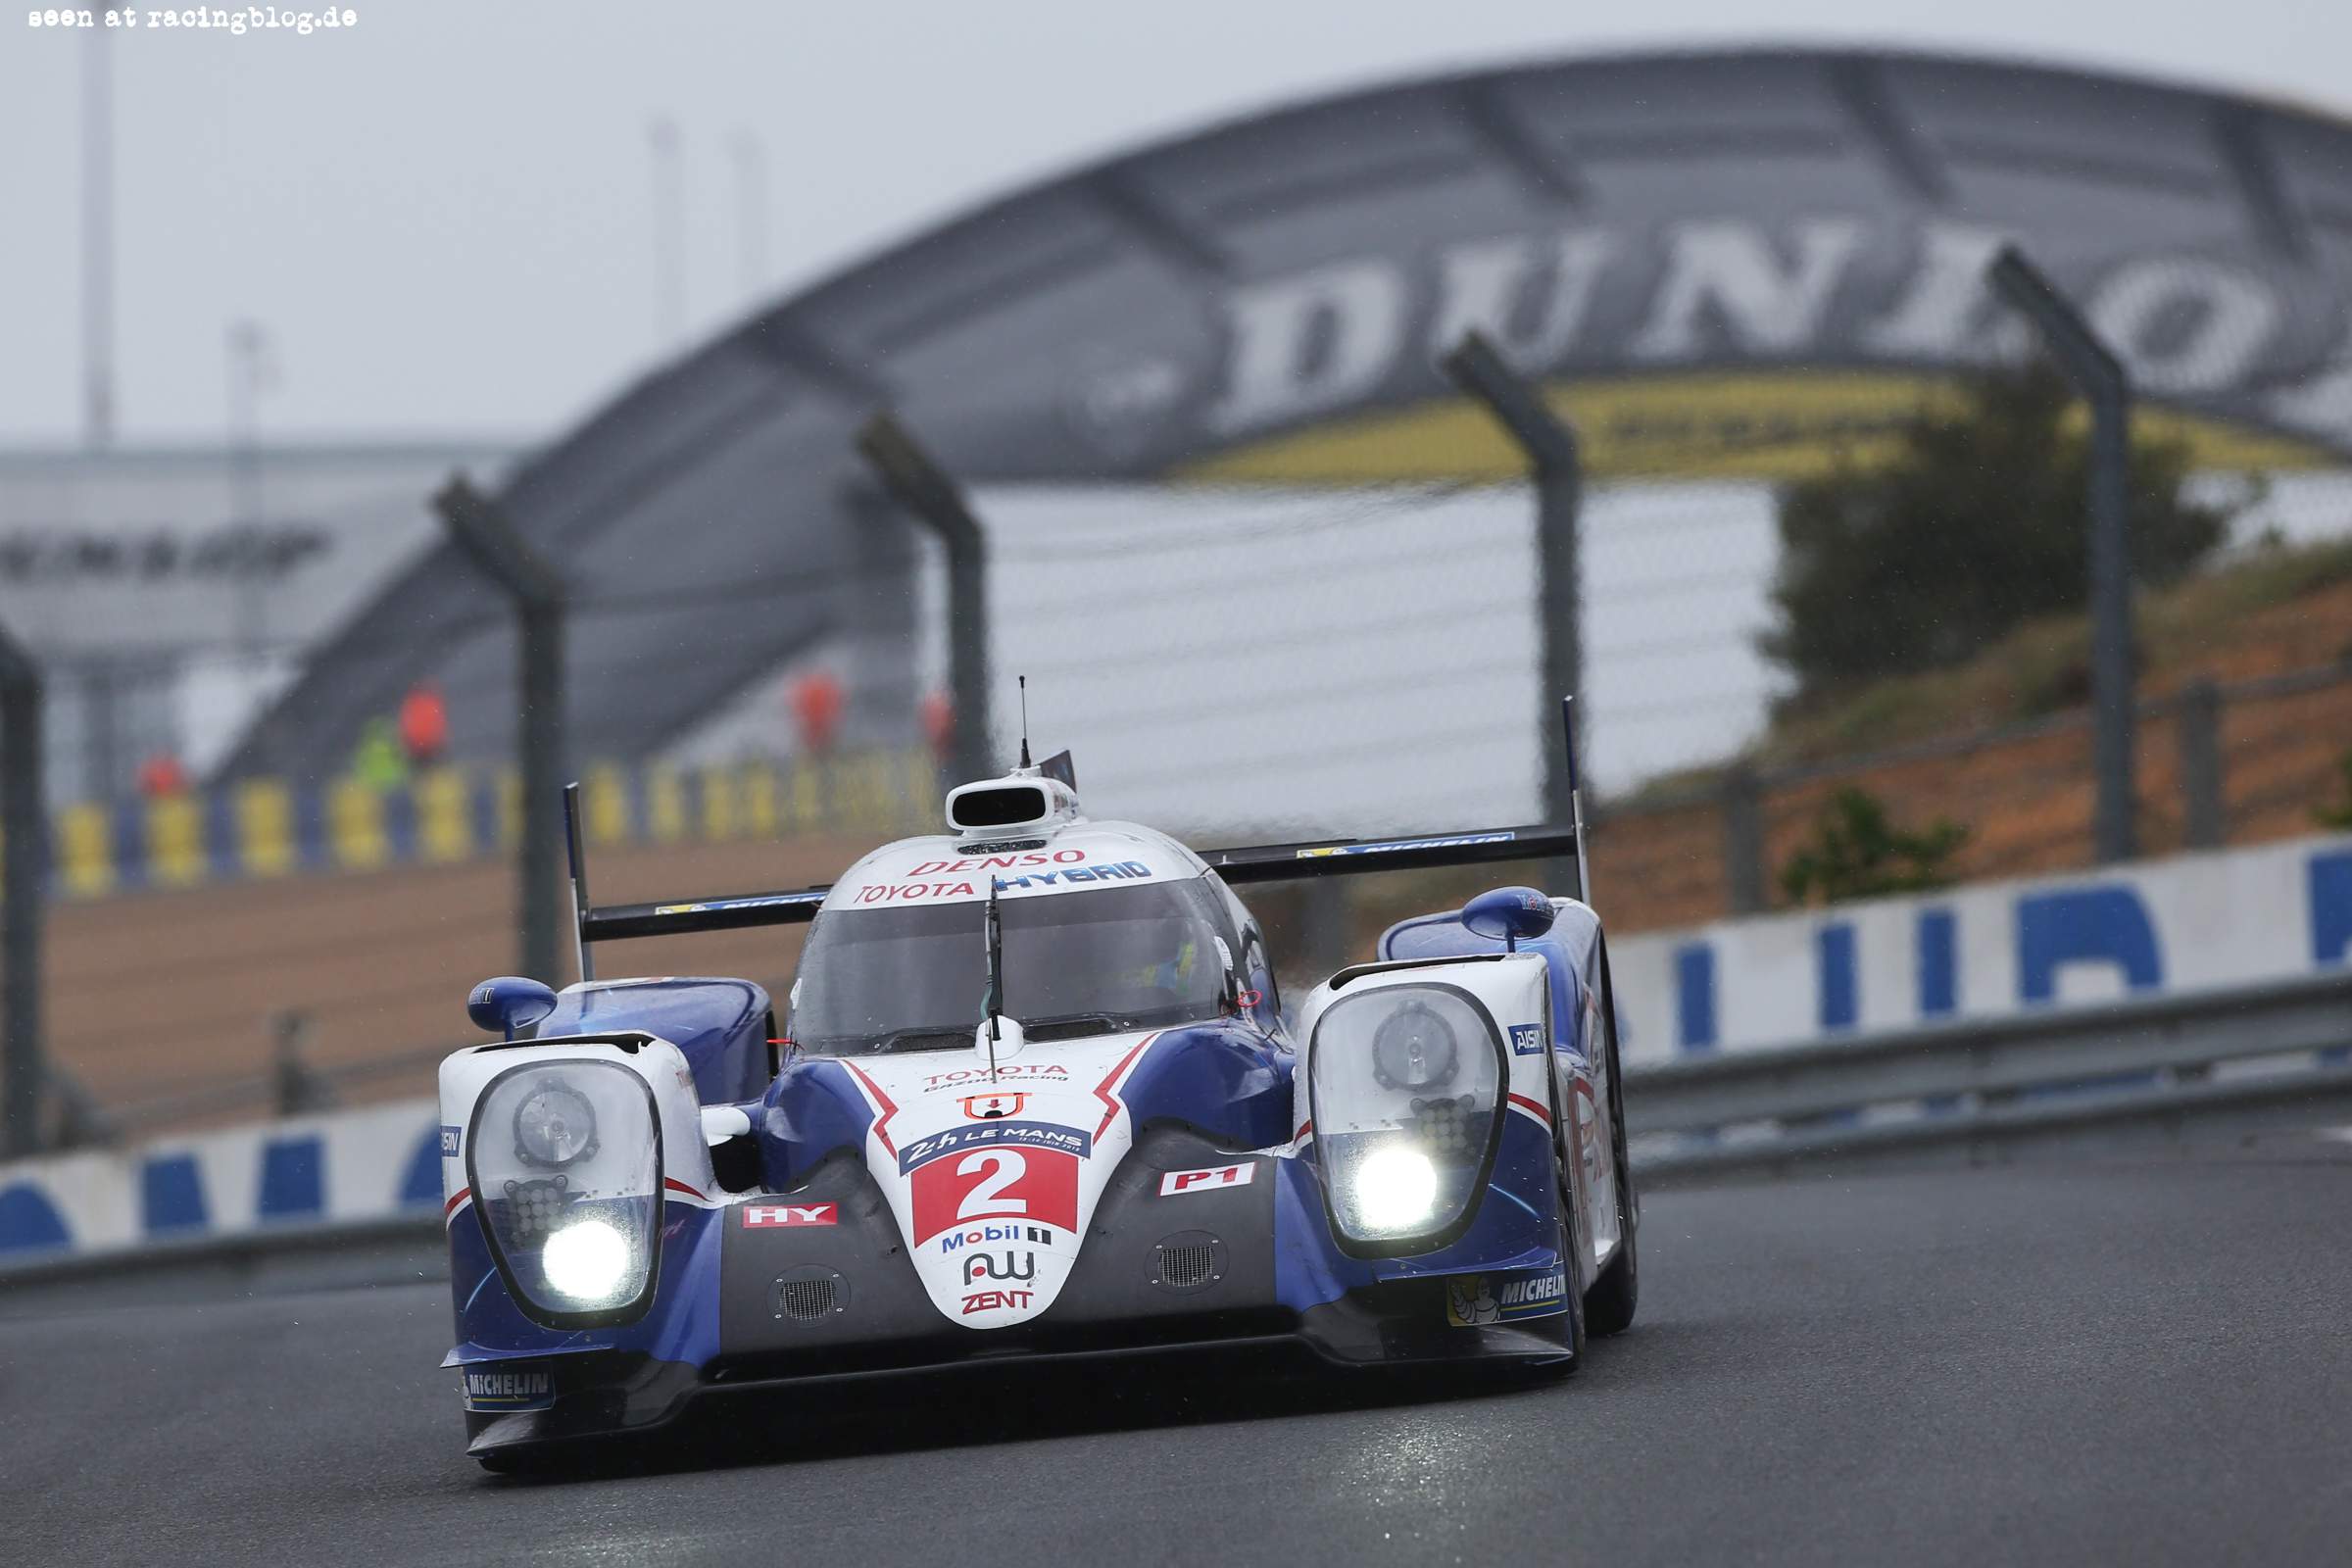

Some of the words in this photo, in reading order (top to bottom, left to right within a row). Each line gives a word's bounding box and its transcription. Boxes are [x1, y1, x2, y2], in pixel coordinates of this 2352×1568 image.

[1210, 218, 2352, 436] DUNLO
[906, 850, 1085, 877] DENSO
[853, 882, 974, 904] TOYOTA
[994, 860, 1152, 892] HYBRID
[923, 1065, 1068, 1085] TOYOTA
[965, 1130, 1000, 1142] LE
[1004, 1128, 1082, 1147] MANS
[956, 1149, 1028, 1220] 2
[1175, 1167, 1239, 1190] P1
[749, 1205, 831, 1223] HY
[942, 1225, 1019, 1254] Mobil
[961, 1290, 1034, 1315] ZENT
[470, 1373, 549, 1396] MICHELIN
